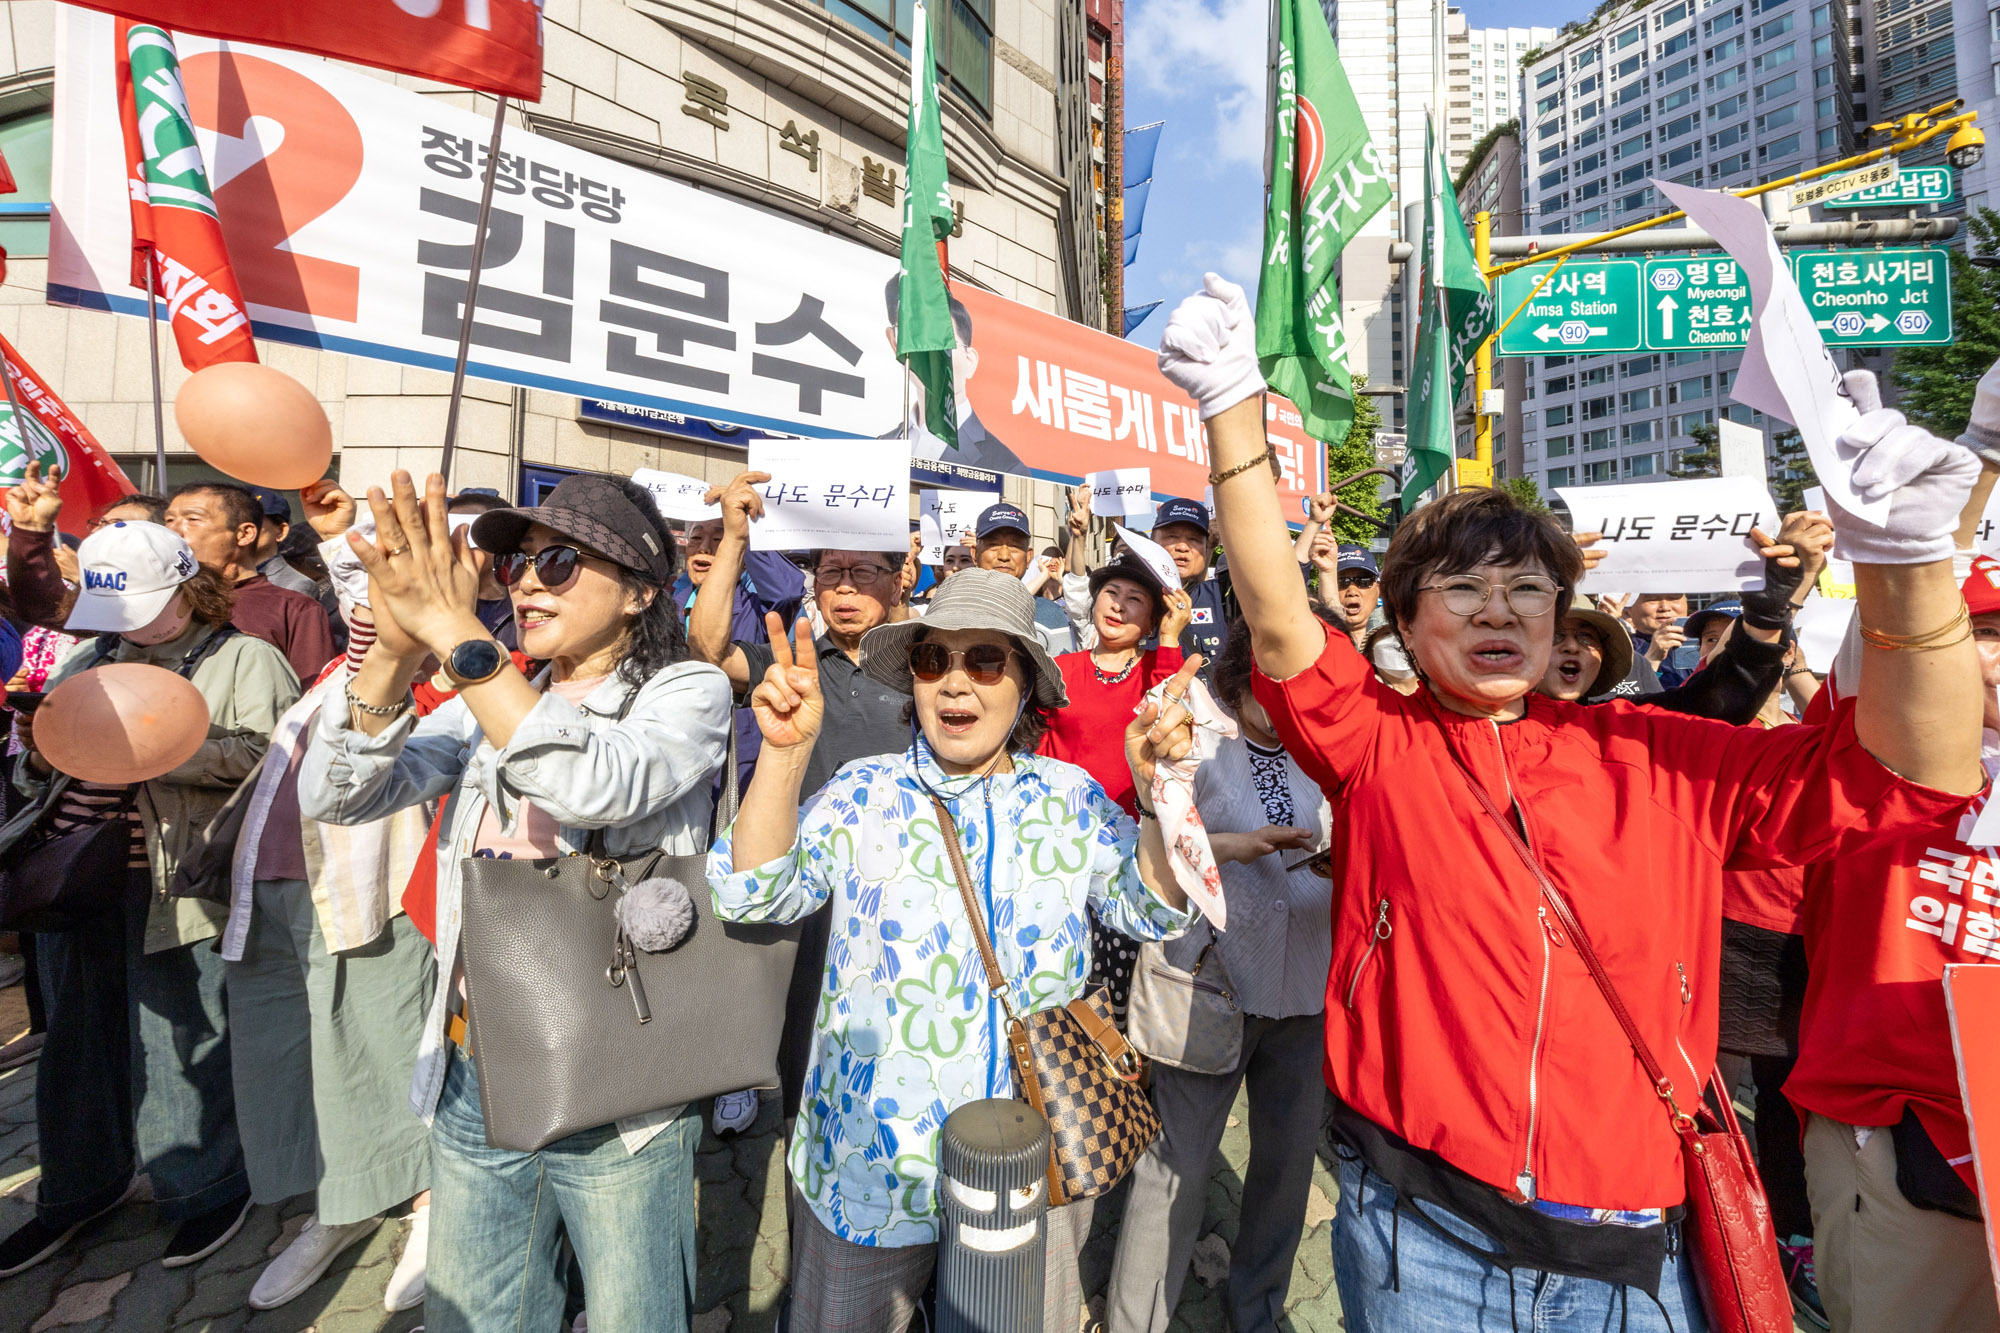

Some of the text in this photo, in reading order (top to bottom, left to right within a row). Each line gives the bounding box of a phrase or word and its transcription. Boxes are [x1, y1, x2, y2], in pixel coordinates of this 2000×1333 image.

[421, 124, 627, 224] 정정당당
[1795, 166, 1890, 204] 방범용 CCTV 작동중
[1838, 172, 1944, 201] 교남단
[1658, 273, 1675, 286] 92
[1687, 262, 1737, 284] 명일
[1812, 259, 1934, 288] 천호사거리
[1530, 270, 1607, 298] 암사역
[417, 186, 866, 417] 김문수
[1687, 287, 1747, 302] Myeongil
[1812, 289, 1929, 308] Cheonho Jct
[1527, 300, 1618, 317] Amsa Station
[1839, 316, 1860, 331] 90
[1903, 315, 1924, 330] 50
[1565, 326, 1584, 339] 90
[1689, 329, 1737, 344] Cheonho
[1012, 355, 1157, 453] 새롭게
[1162, 400, 1306, 492] 대국!
[1278, 409, 1304, 430] 국민의
[677, 484, 708, 495] 문수
[764, 482, 897, 509] 나도 문수다
[1093, 484, 1144, 497] 나도 문수다
[931, 501, 957, 515] 나도
[944, 523, 977, 538] 문수
[1600, 512, 1760, 542] 나도 문수다
[932, 546, 942, 559] 문
[84, 568, 127, 591] WAAC
